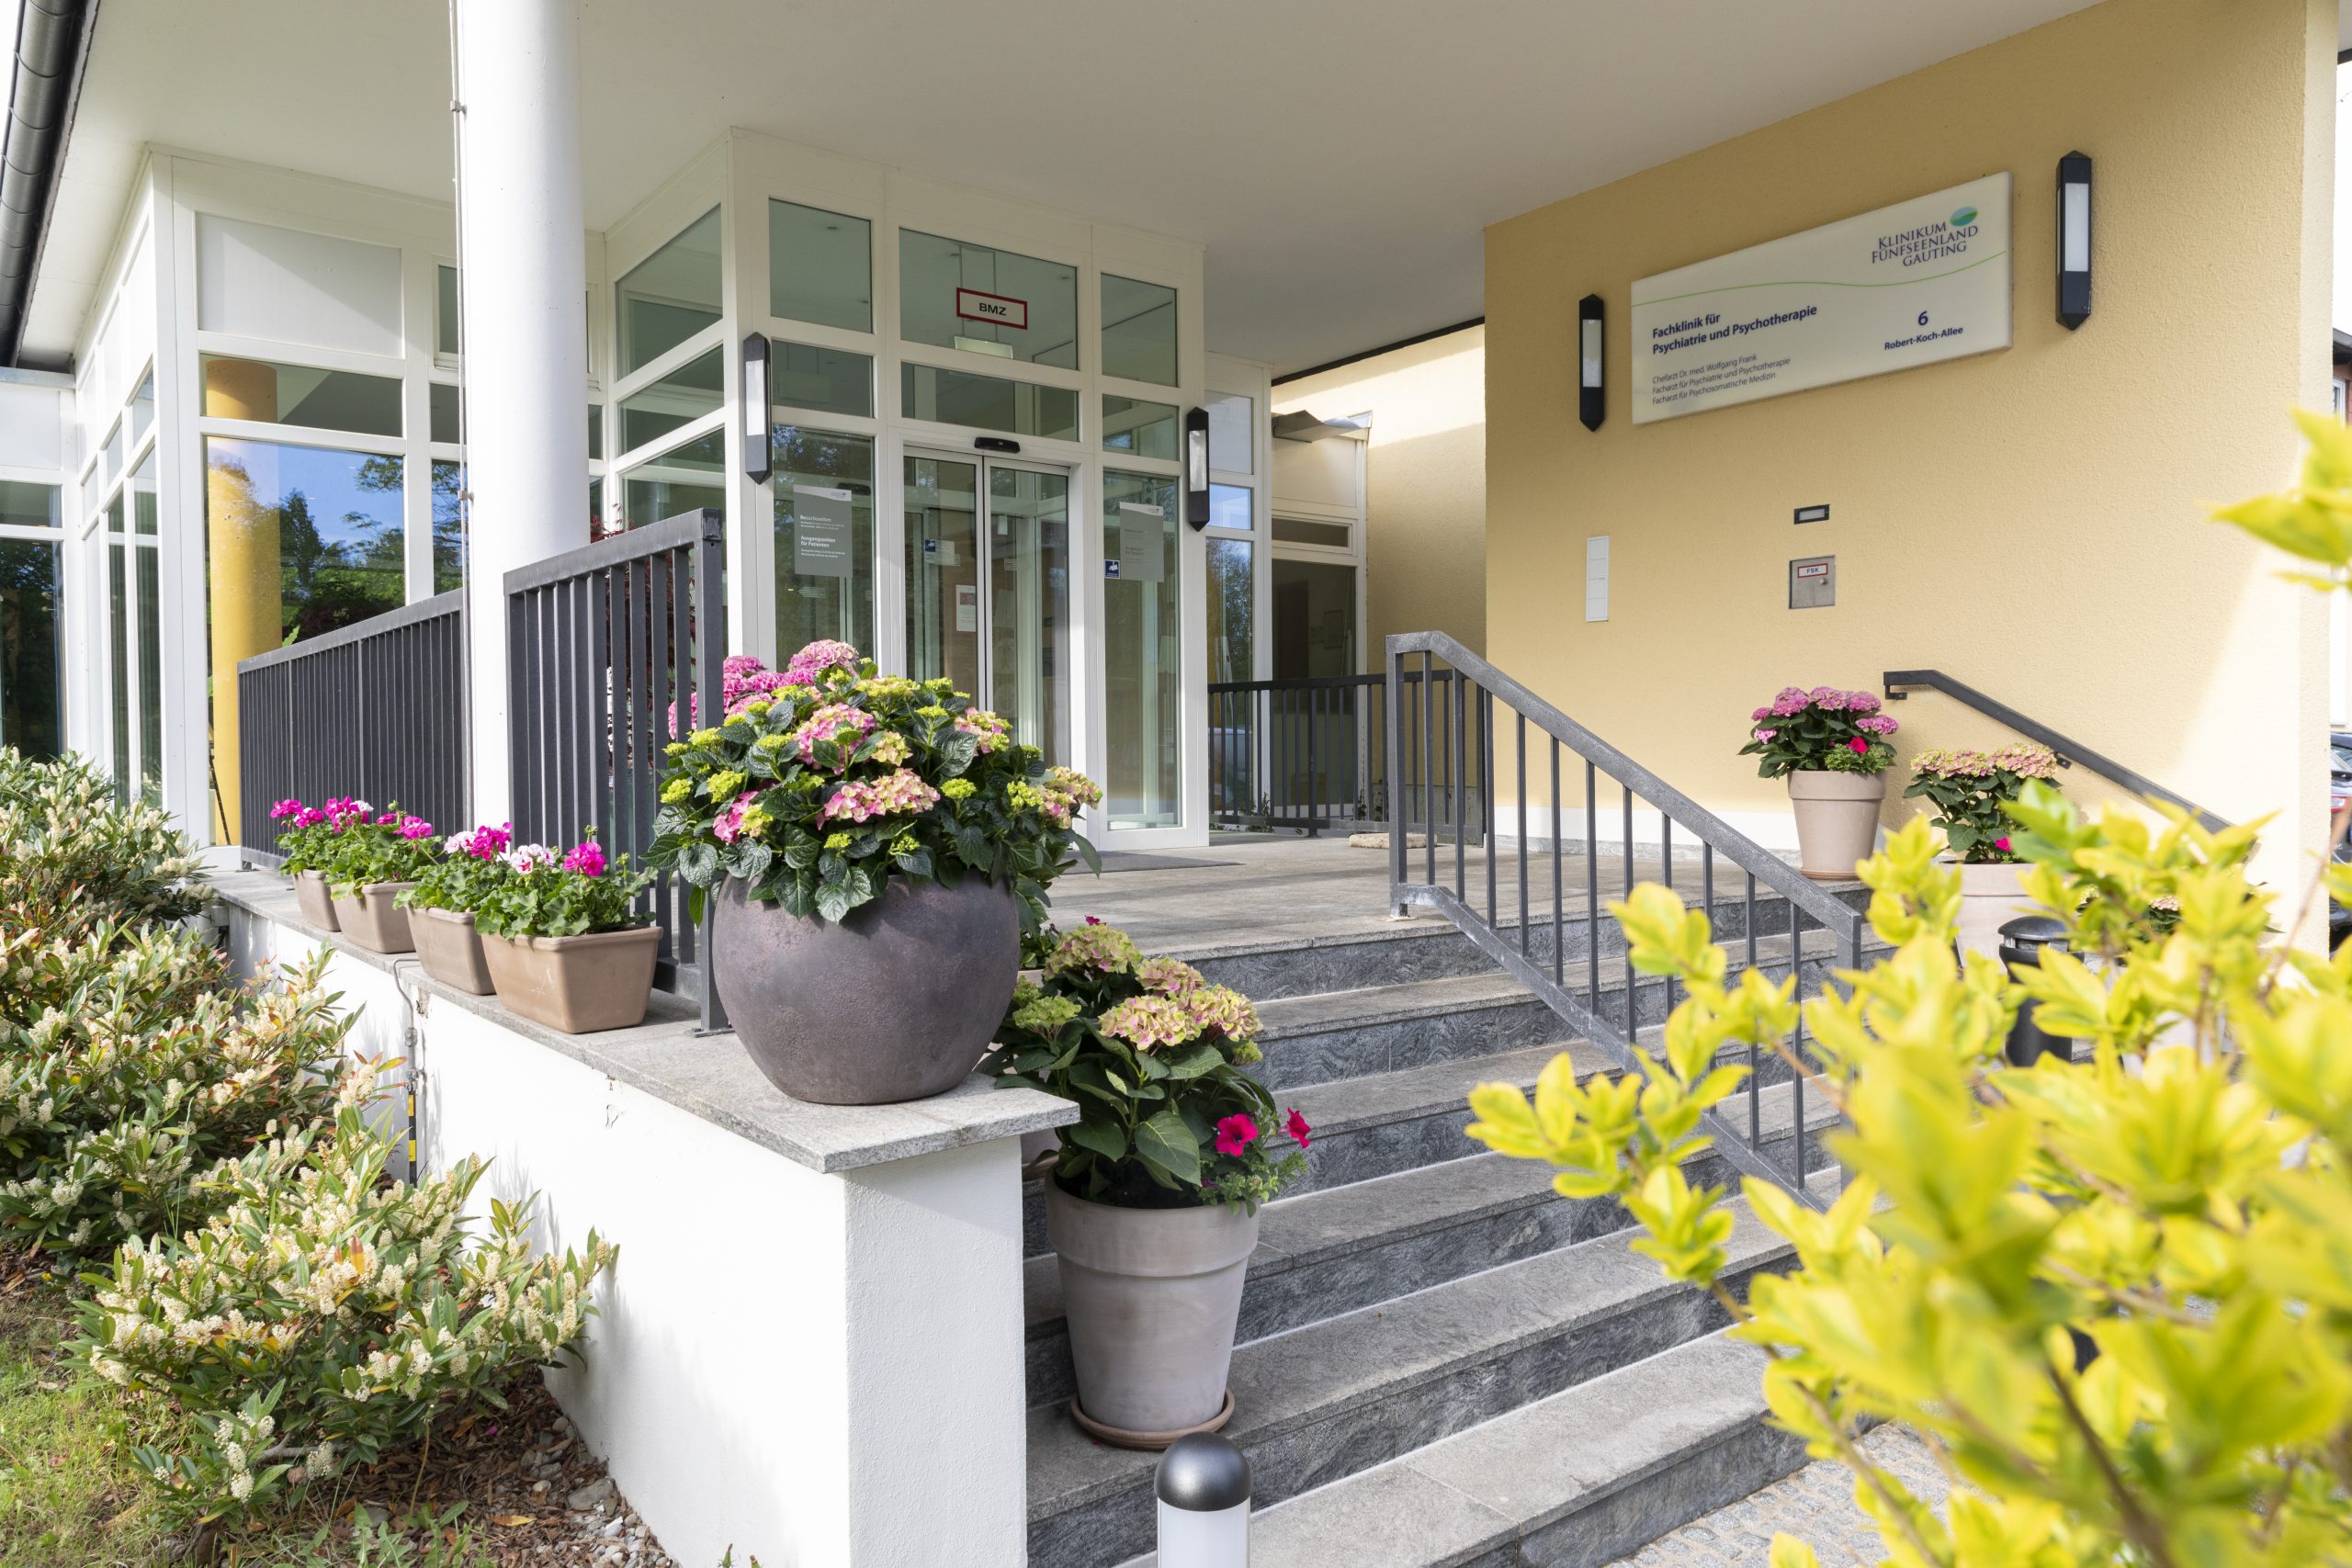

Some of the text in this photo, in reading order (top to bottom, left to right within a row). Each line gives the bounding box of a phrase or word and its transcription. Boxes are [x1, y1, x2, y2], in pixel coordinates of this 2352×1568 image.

[1871, 225, 1978, 264] FÜNFSEENLAND
[1878, 221, 1947, 249] KLINIKUM
[1903, 241, 1966, 266] GAUTING
[979, 302, 1006, 316] BMZ
[1917, 310, 1928, 326] 6
[1652, 313, 1720, 339] Fachklinik für
[1652, 306, 1817, 355] Psychiatrie und Psychotherapie
[1884, 326, 1963, 350] Robert-Koch-Allee
[1653, 354, 1757, 384] Chefarzt Dr. med. Wolfgang Frank
[1653, 358, 1791, 395] Facharzt für Psychiatrie und Psychotherapie
[1653, 371, 1776, 404] Facharzt für Psychosomatische Medizin
